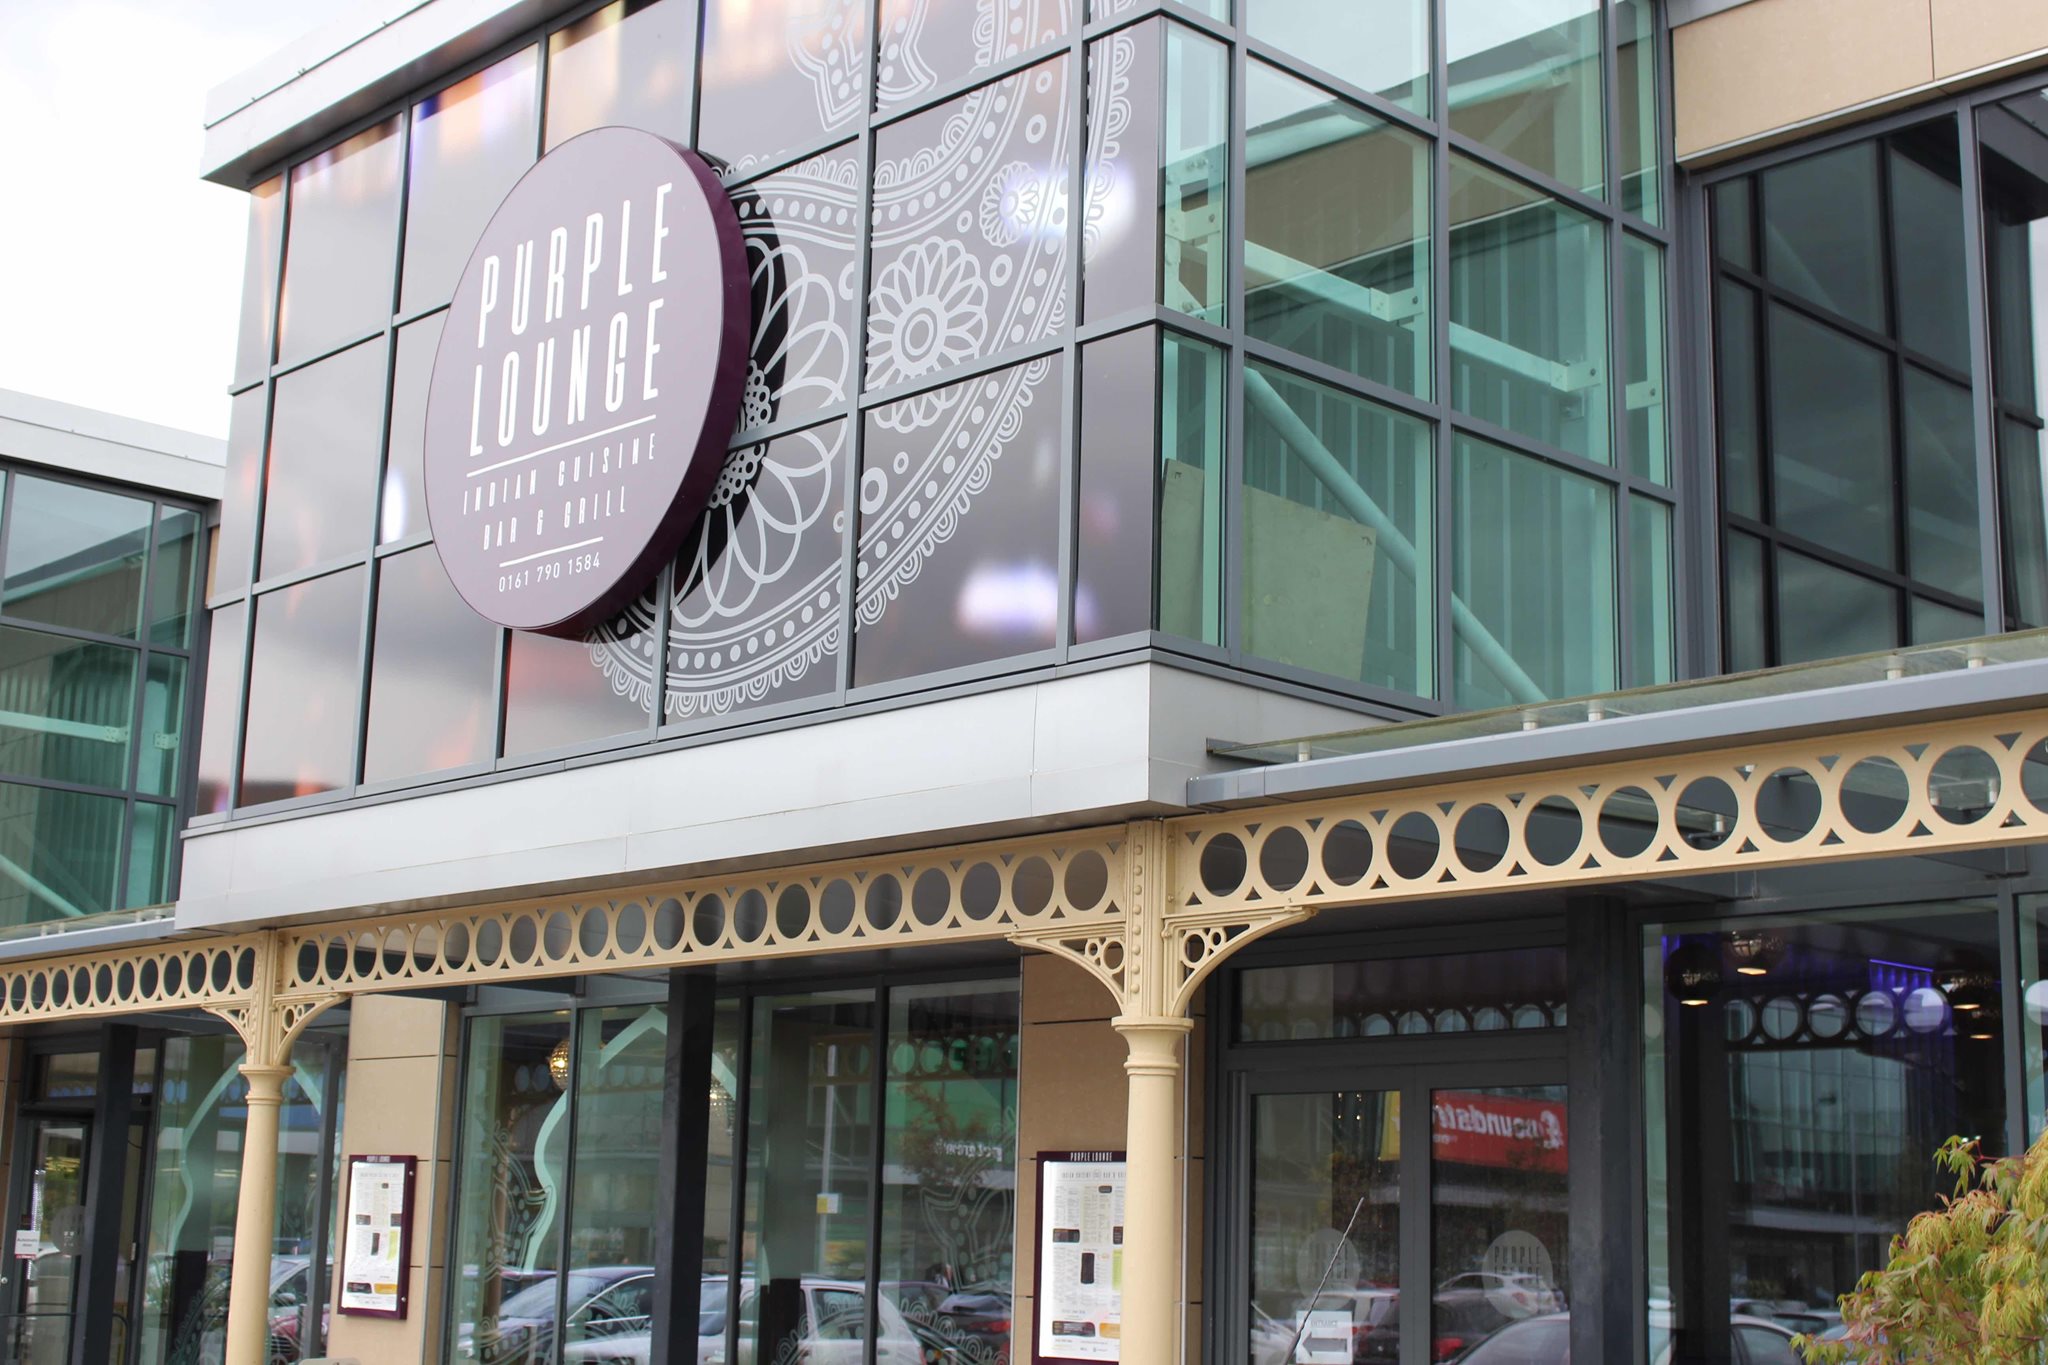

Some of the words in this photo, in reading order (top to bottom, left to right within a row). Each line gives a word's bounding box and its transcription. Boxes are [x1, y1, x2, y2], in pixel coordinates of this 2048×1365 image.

[477, 182, 672, 348] PURPLE
[469, 298, 665, 457] LOUNGE
[463, 469, 537, 515] INDIAN
[558, 433, 656, 486] CUISINE
[483, 517, 517, 550] BAR
[536, 509, 544, 536] &
[564, 485, 625, 528] GRILL
[499, 570, 529, 592] 0161
[537, 561, 560, 582] 790
[568, 552, 600, 575] 1584
